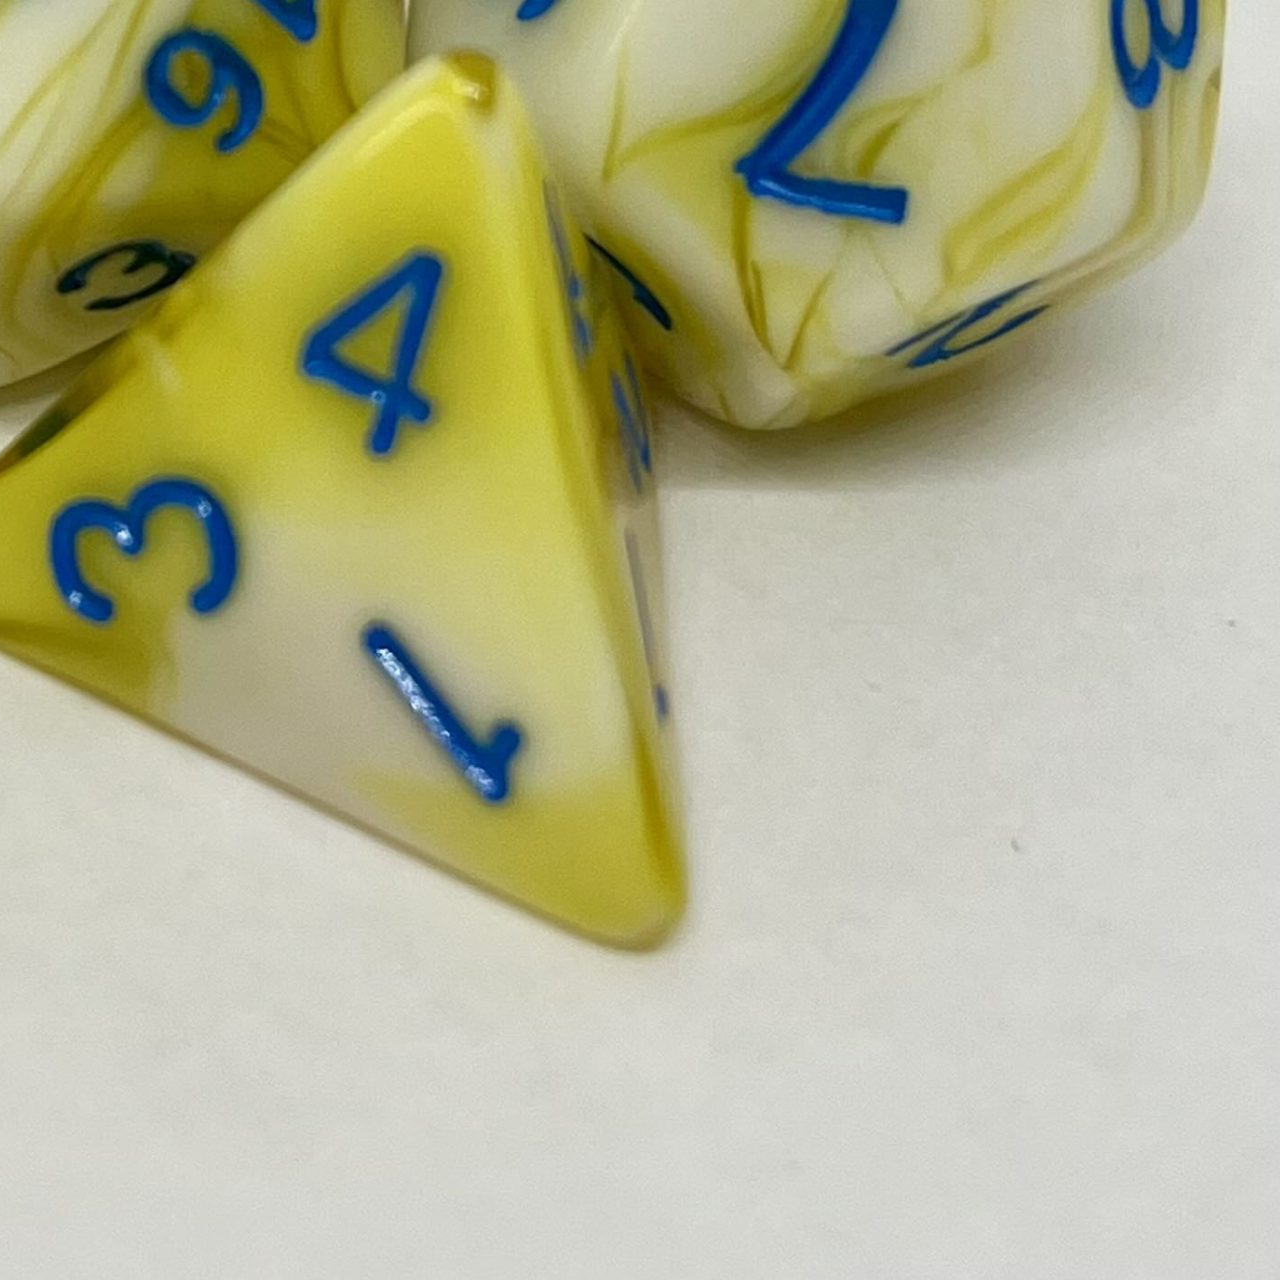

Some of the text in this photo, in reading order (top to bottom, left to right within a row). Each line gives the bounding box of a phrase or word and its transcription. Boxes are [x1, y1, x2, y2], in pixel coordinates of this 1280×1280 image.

[302, 250, 444, 456] 4
[48, 476, 239, 624] 3
[363, 622, 526, 804] 1
